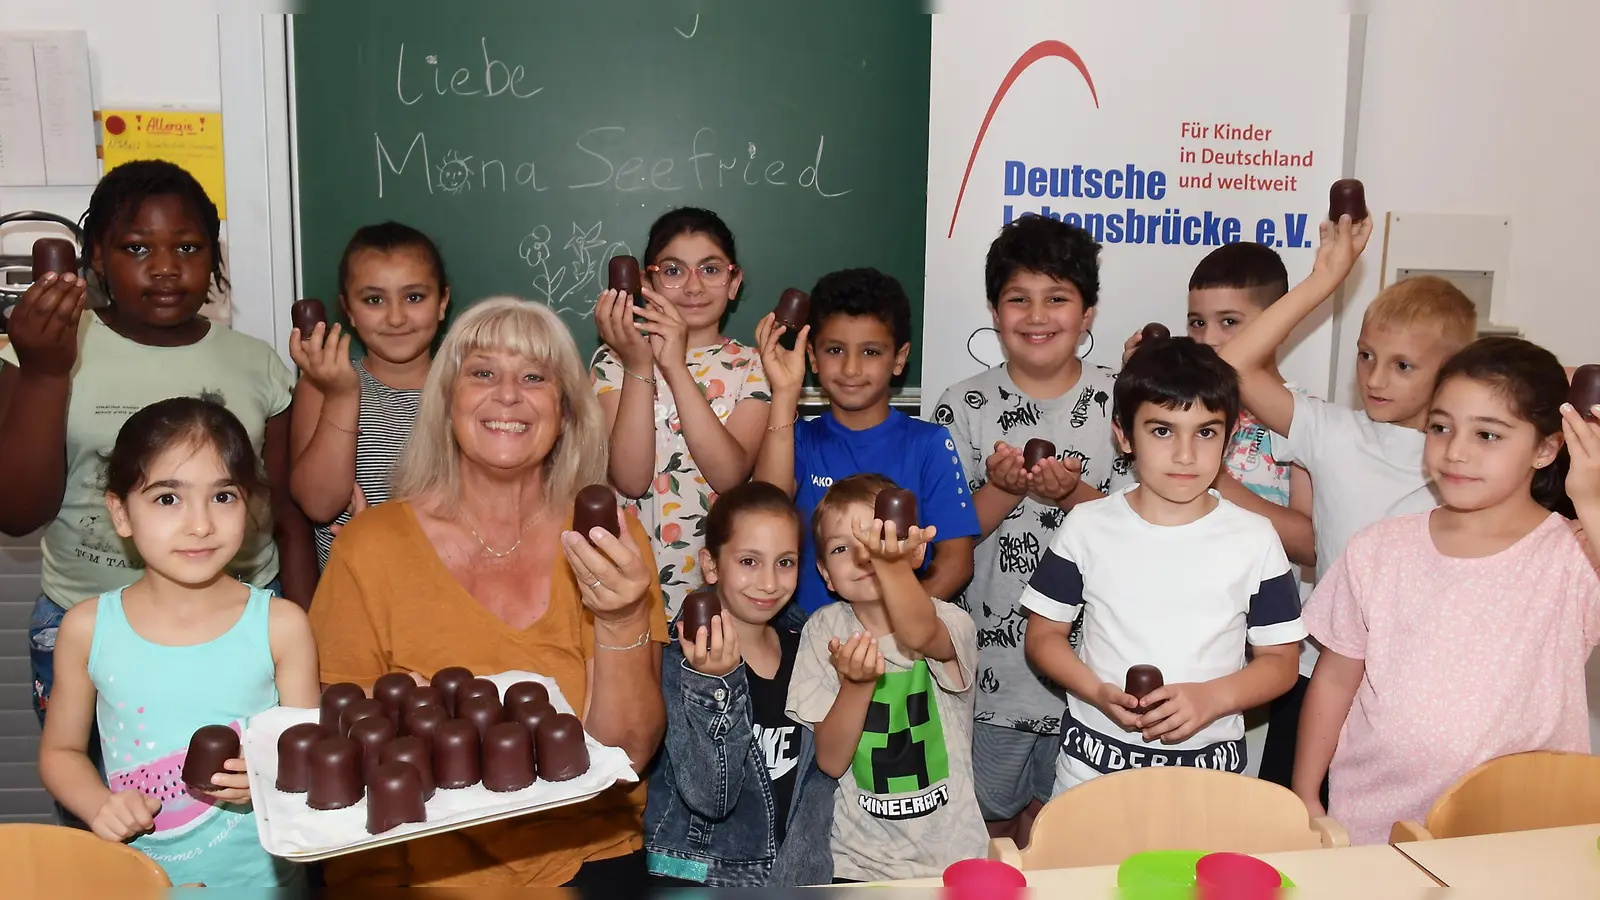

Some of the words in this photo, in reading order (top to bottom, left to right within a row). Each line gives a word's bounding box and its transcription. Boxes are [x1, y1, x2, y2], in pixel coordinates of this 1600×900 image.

[397, 36, 544, 105] Liebe
[146, 117, 194, 136] Allergie
[1181, 121, 1209, 139] Für
[1213, 123, 1272, 142] Kinder
[374, 131, 549, 199] Mona
[568, 126, 852, 198] Seefried
[1180, 147, 1196, 163] in
[1201, 148, 1314, 168] Deutschland
[1004, 160, 1167, 200] Deutsche
[1178, 172, 1213, 189] und
[1217, 174, 1297, 192] weltweit
[1003, 204, 1241, 246] ensbrücke
[1255, 212, 1312, 248] e.V.
[858, 784, 949, 820] MINECRAFT
